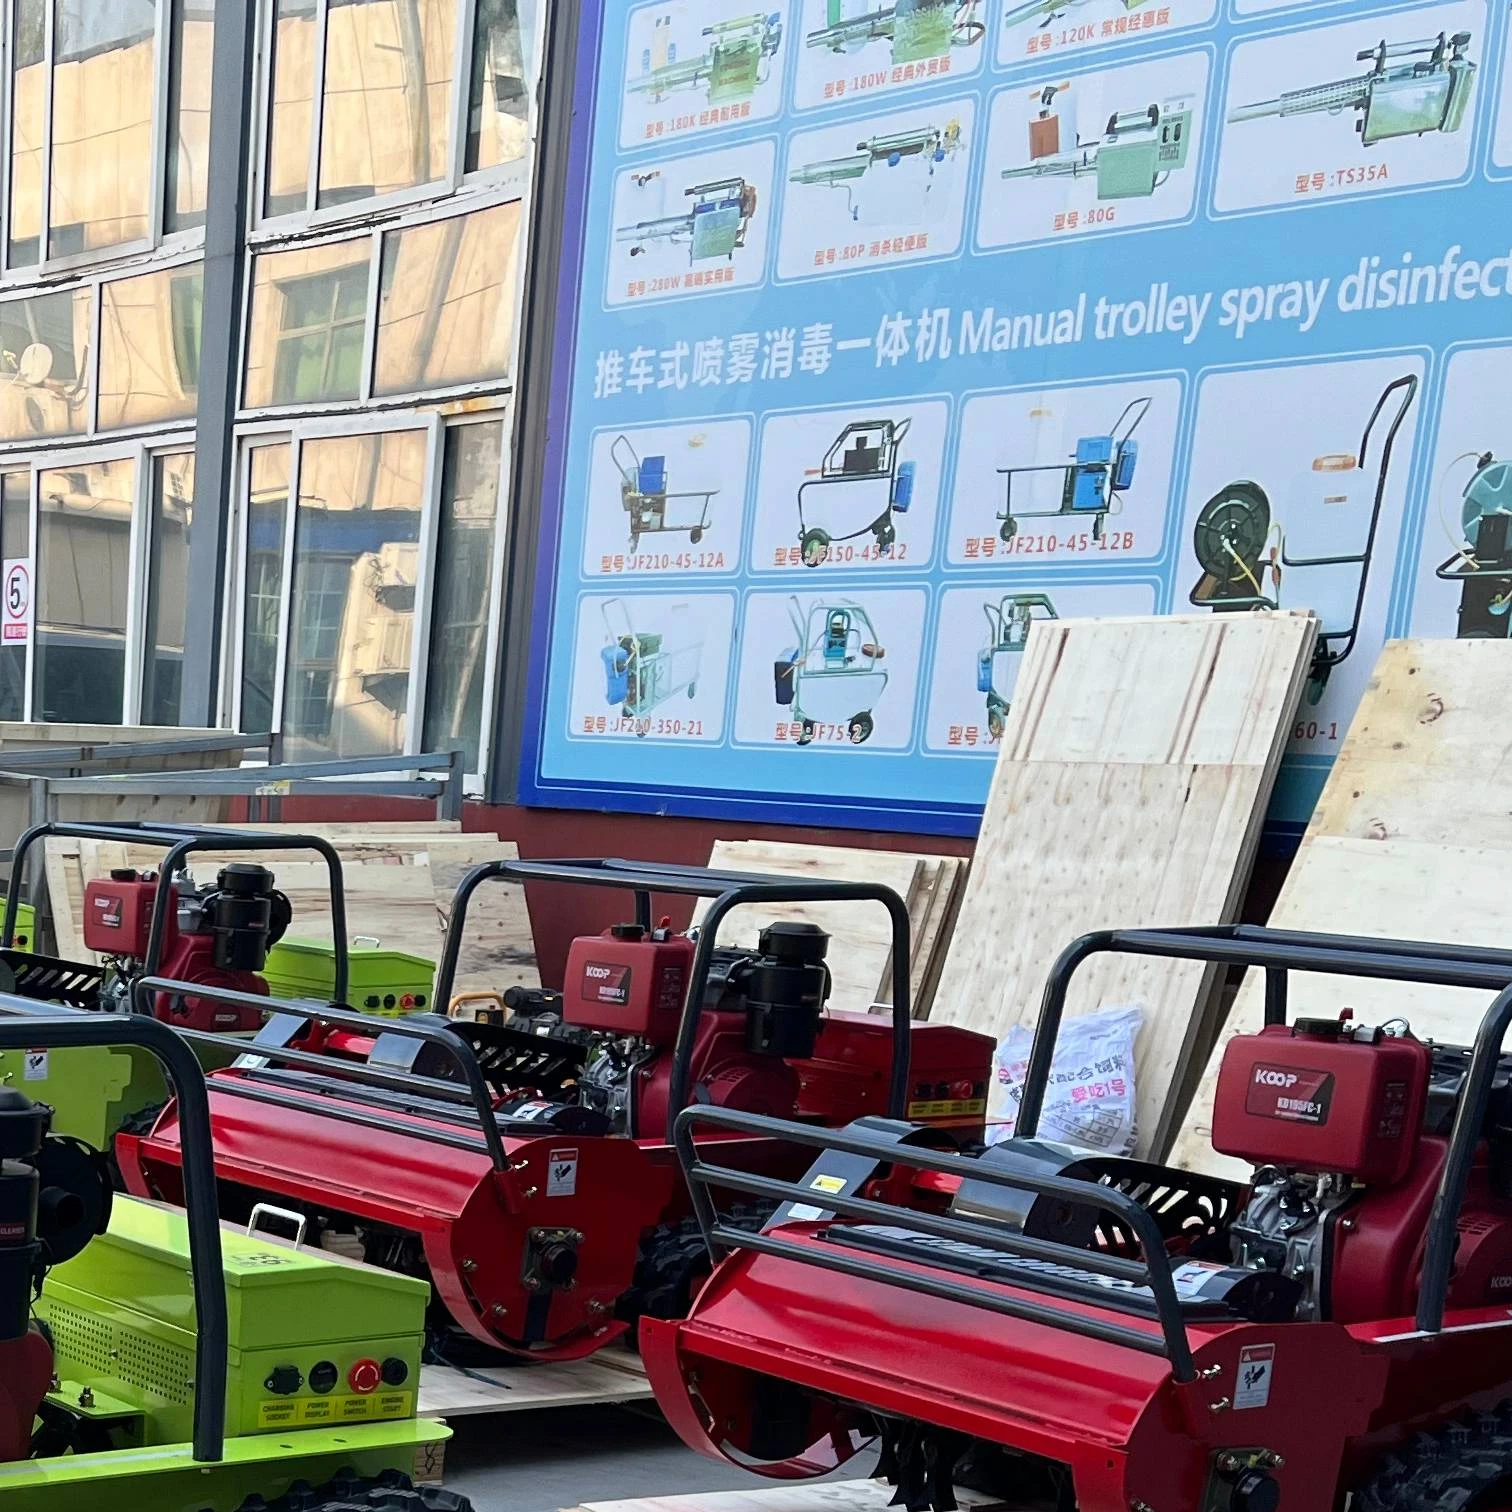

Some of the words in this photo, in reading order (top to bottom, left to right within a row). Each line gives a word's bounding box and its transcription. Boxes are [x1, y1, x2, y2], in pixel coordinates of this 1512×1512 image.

[593, 307, 952, 399] 推车式喷雾消毒一体机
[957, 293, 1086, 356] Manual
[1094, 282, 1213, 344] trolley
[1218, 276, 1331, 338] spray
[10, 577, 20, 609] 5
[1294, 721, 1338, 741] 60-1
[586, 966, 610, 979] KOOP
[1256, 1069, 1297, 1087] KOOP
[304, 1410, 331, 1419] DISPLAY
[306, 1402, 330, 1410] POWER
